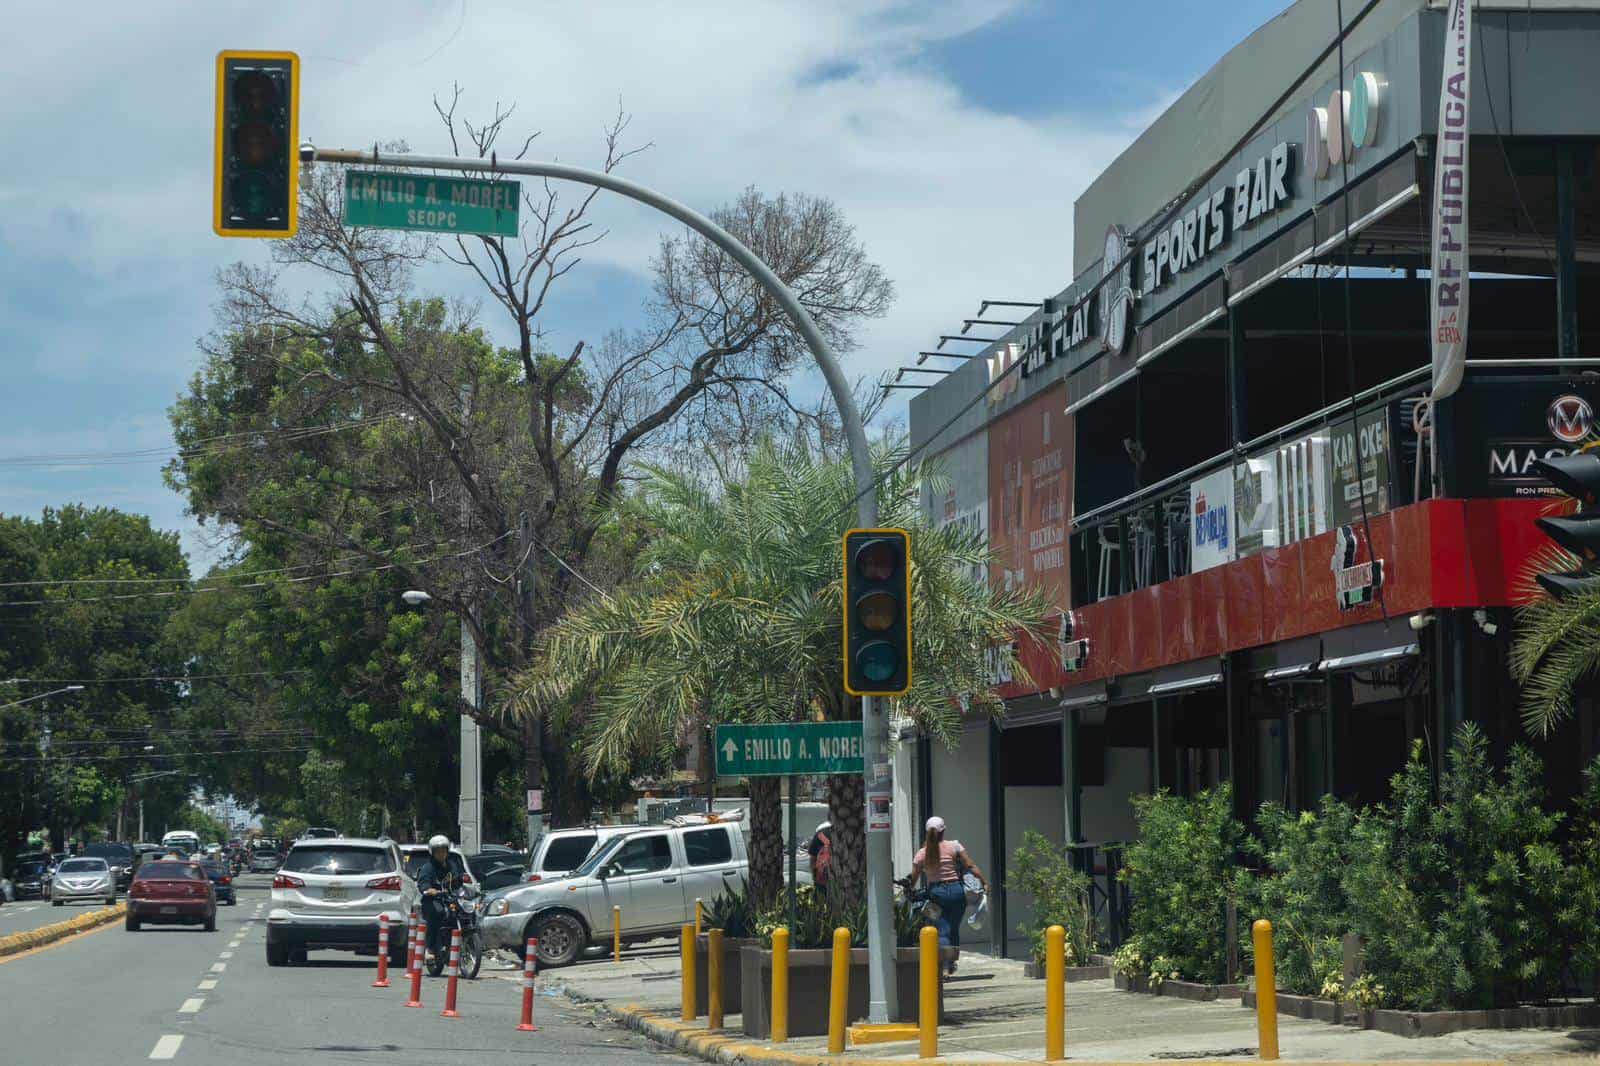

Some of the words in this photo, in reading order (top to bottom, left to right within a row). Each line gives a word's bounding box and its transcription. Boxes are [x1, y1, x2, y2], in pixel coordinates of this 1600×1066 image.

[352, 176, 416, 204] EMILIO
[425, 183, 441, 205] A.
[451, 184, 514, 209] MOREL
[407, 209, 457, 228] SEOPC
[1143, 186, 1228, 295] SPORTS
[1232, 141, 1289, 231] BAR
[1333, 421, 1383, 468] KAROKE
[1516, 487, 1536, 495] RON
[744, 738, 791, 761] EMILIO
[799, 738, 812, 760] A.
[819, 736, 864, 759] MOREL
